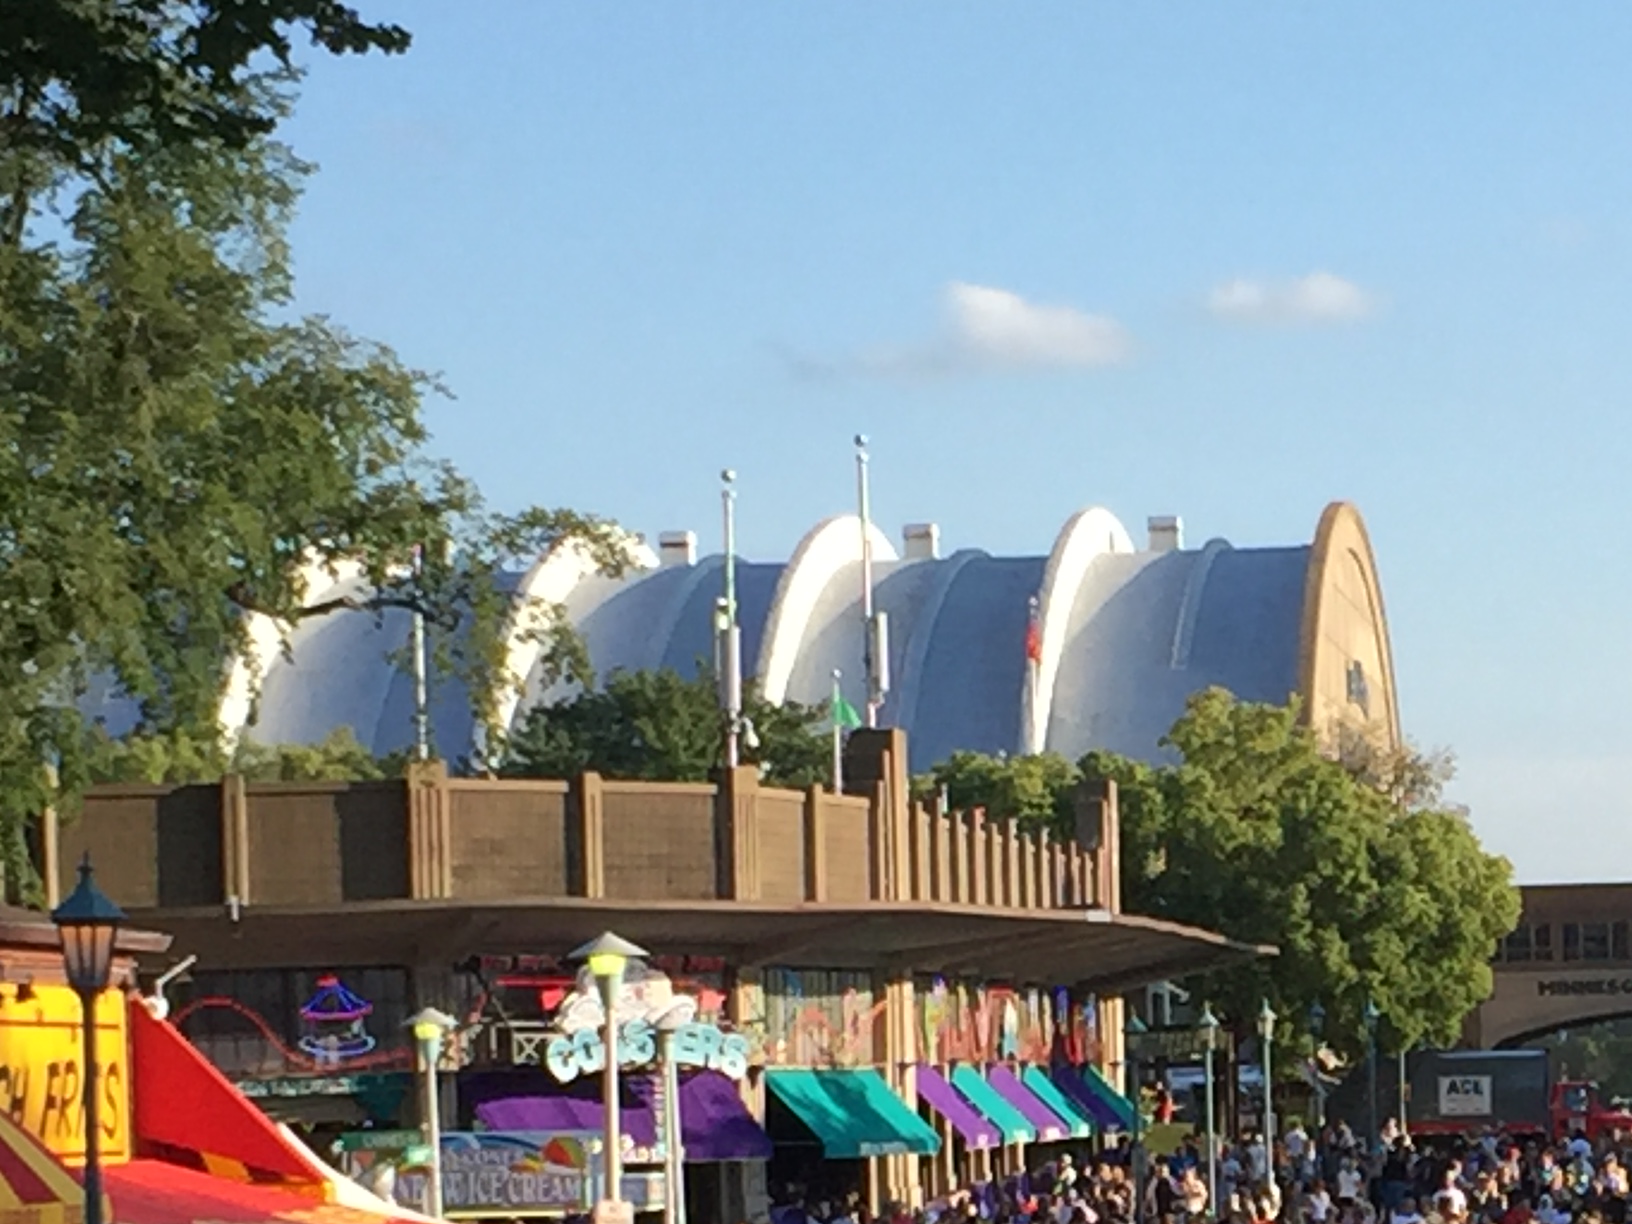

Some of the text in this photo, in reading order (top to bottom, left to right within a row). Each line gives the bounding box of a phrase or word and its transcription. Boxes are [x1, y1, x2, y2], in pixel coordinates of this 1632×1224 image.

[1447, 1079, 1483, 1095] ACL
[467, 1174, 504, 1203] ICE
[508, 1174, 582, 1204] CREAM
